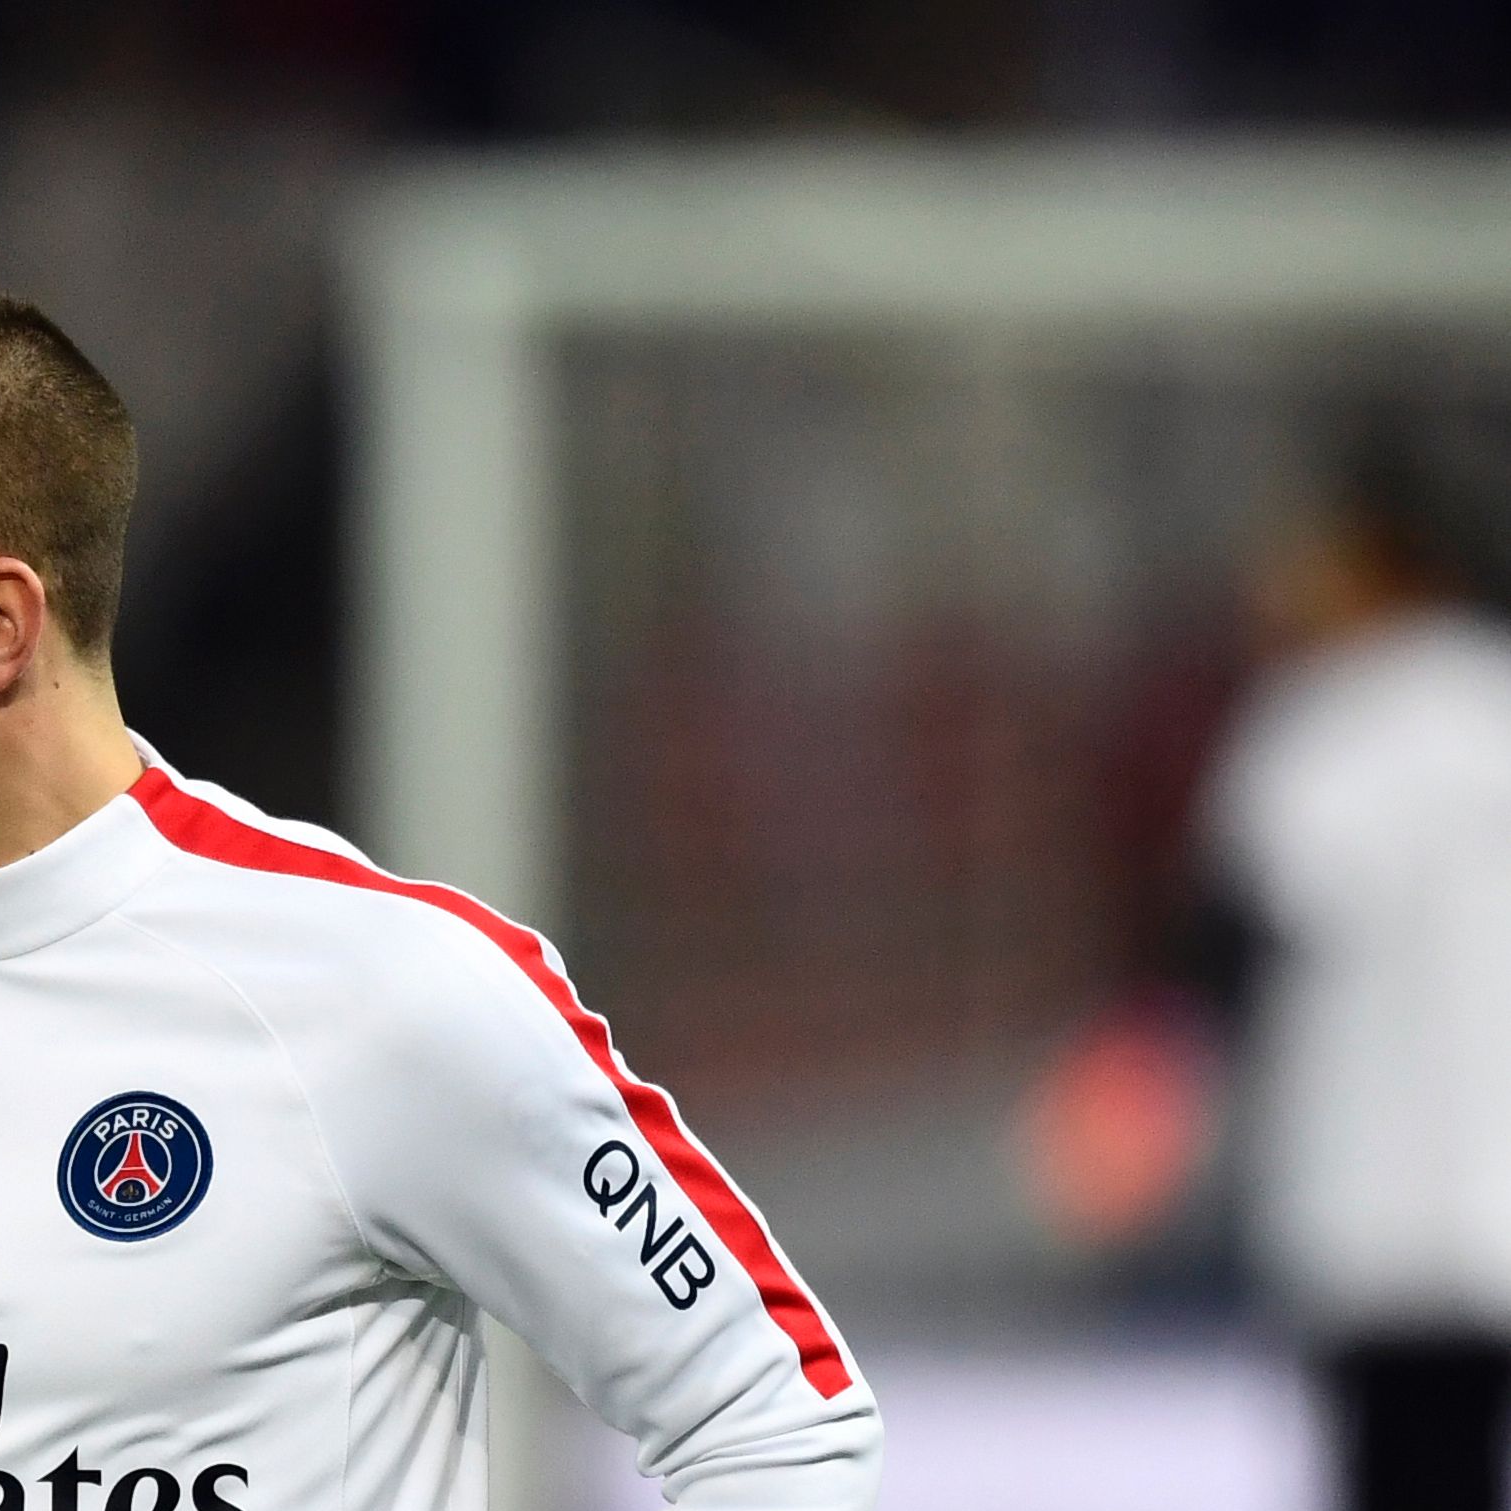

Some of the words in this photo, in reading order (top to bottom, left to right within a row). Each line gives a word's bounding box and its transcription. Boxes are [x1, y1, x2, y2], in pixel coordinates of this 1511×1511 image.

[93, 1109, 179, 1143] PARIS
[87, 1199, 116, 1220] SAINT
[124, 1196, 173, 1222] GERMAIN
[583, 1140, 716, 1311] QNB
